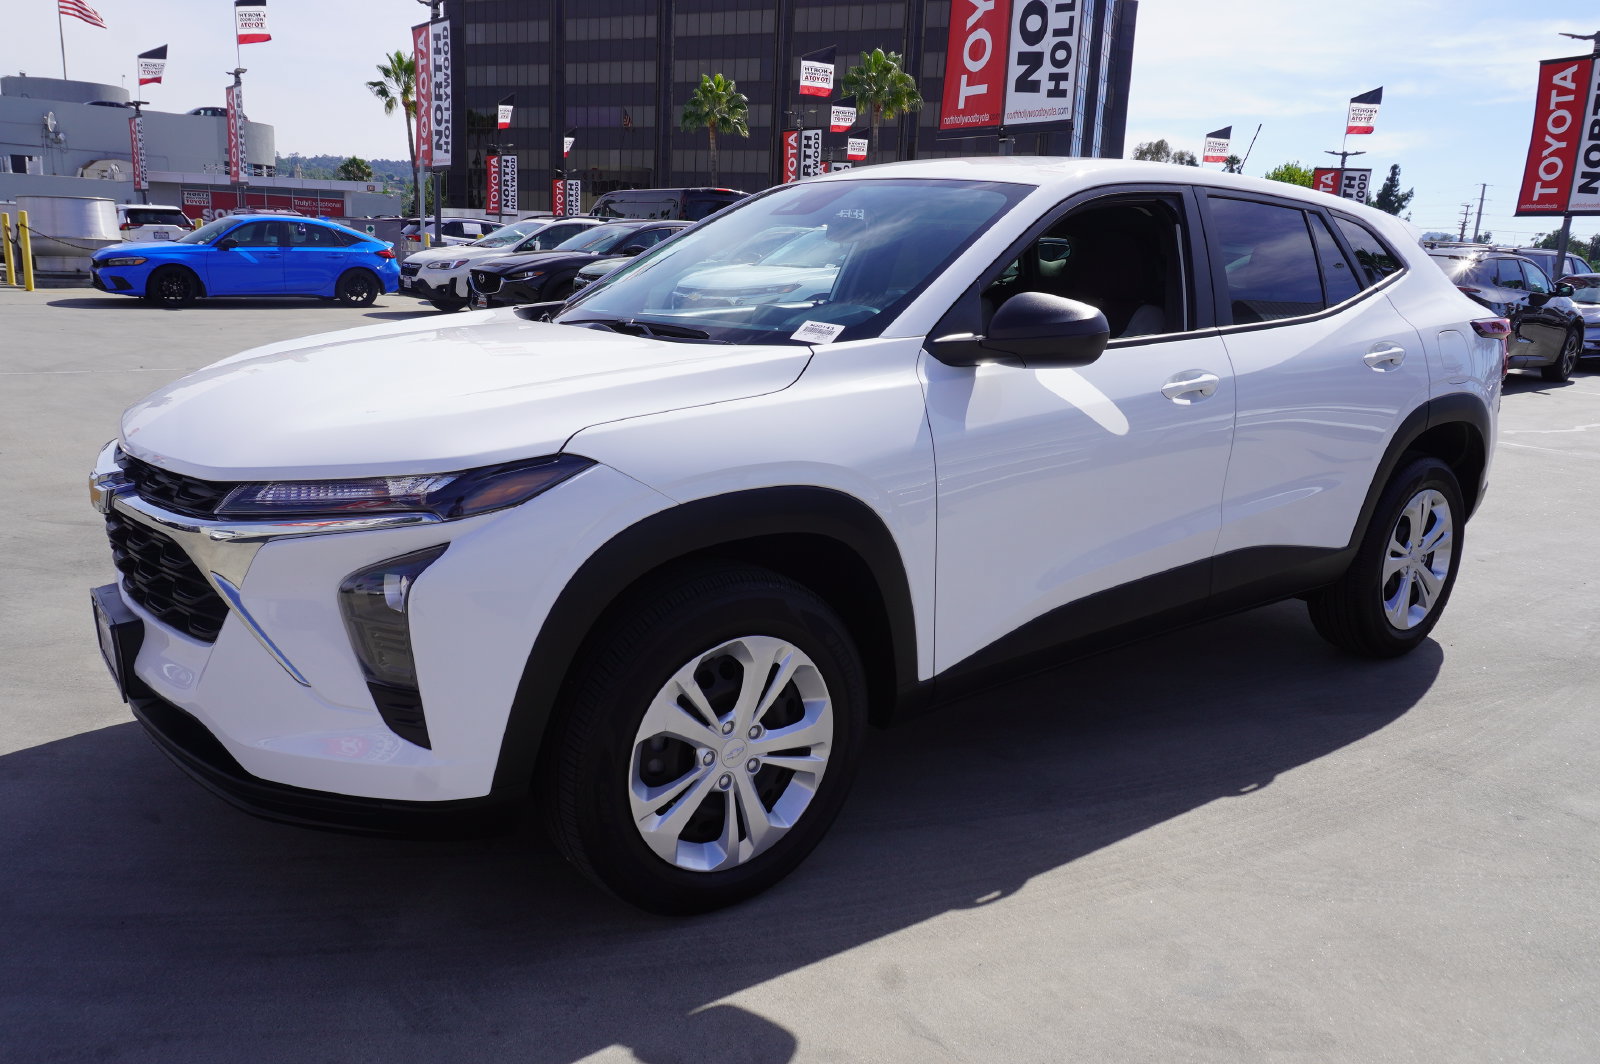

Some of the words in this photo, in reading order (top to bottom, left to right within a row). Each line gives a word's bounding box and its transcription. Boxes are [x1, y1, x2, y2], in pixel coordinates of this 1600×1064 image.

[417, 30, 429, 157] TOYOTA
[433, 32, 444, 152] NORTH
[442, 25, 451, 155] HOLLYWOOD
[1532, 63, 1579, 201] TOYOTA
[490, 156, 499, 209] TOYOTA
